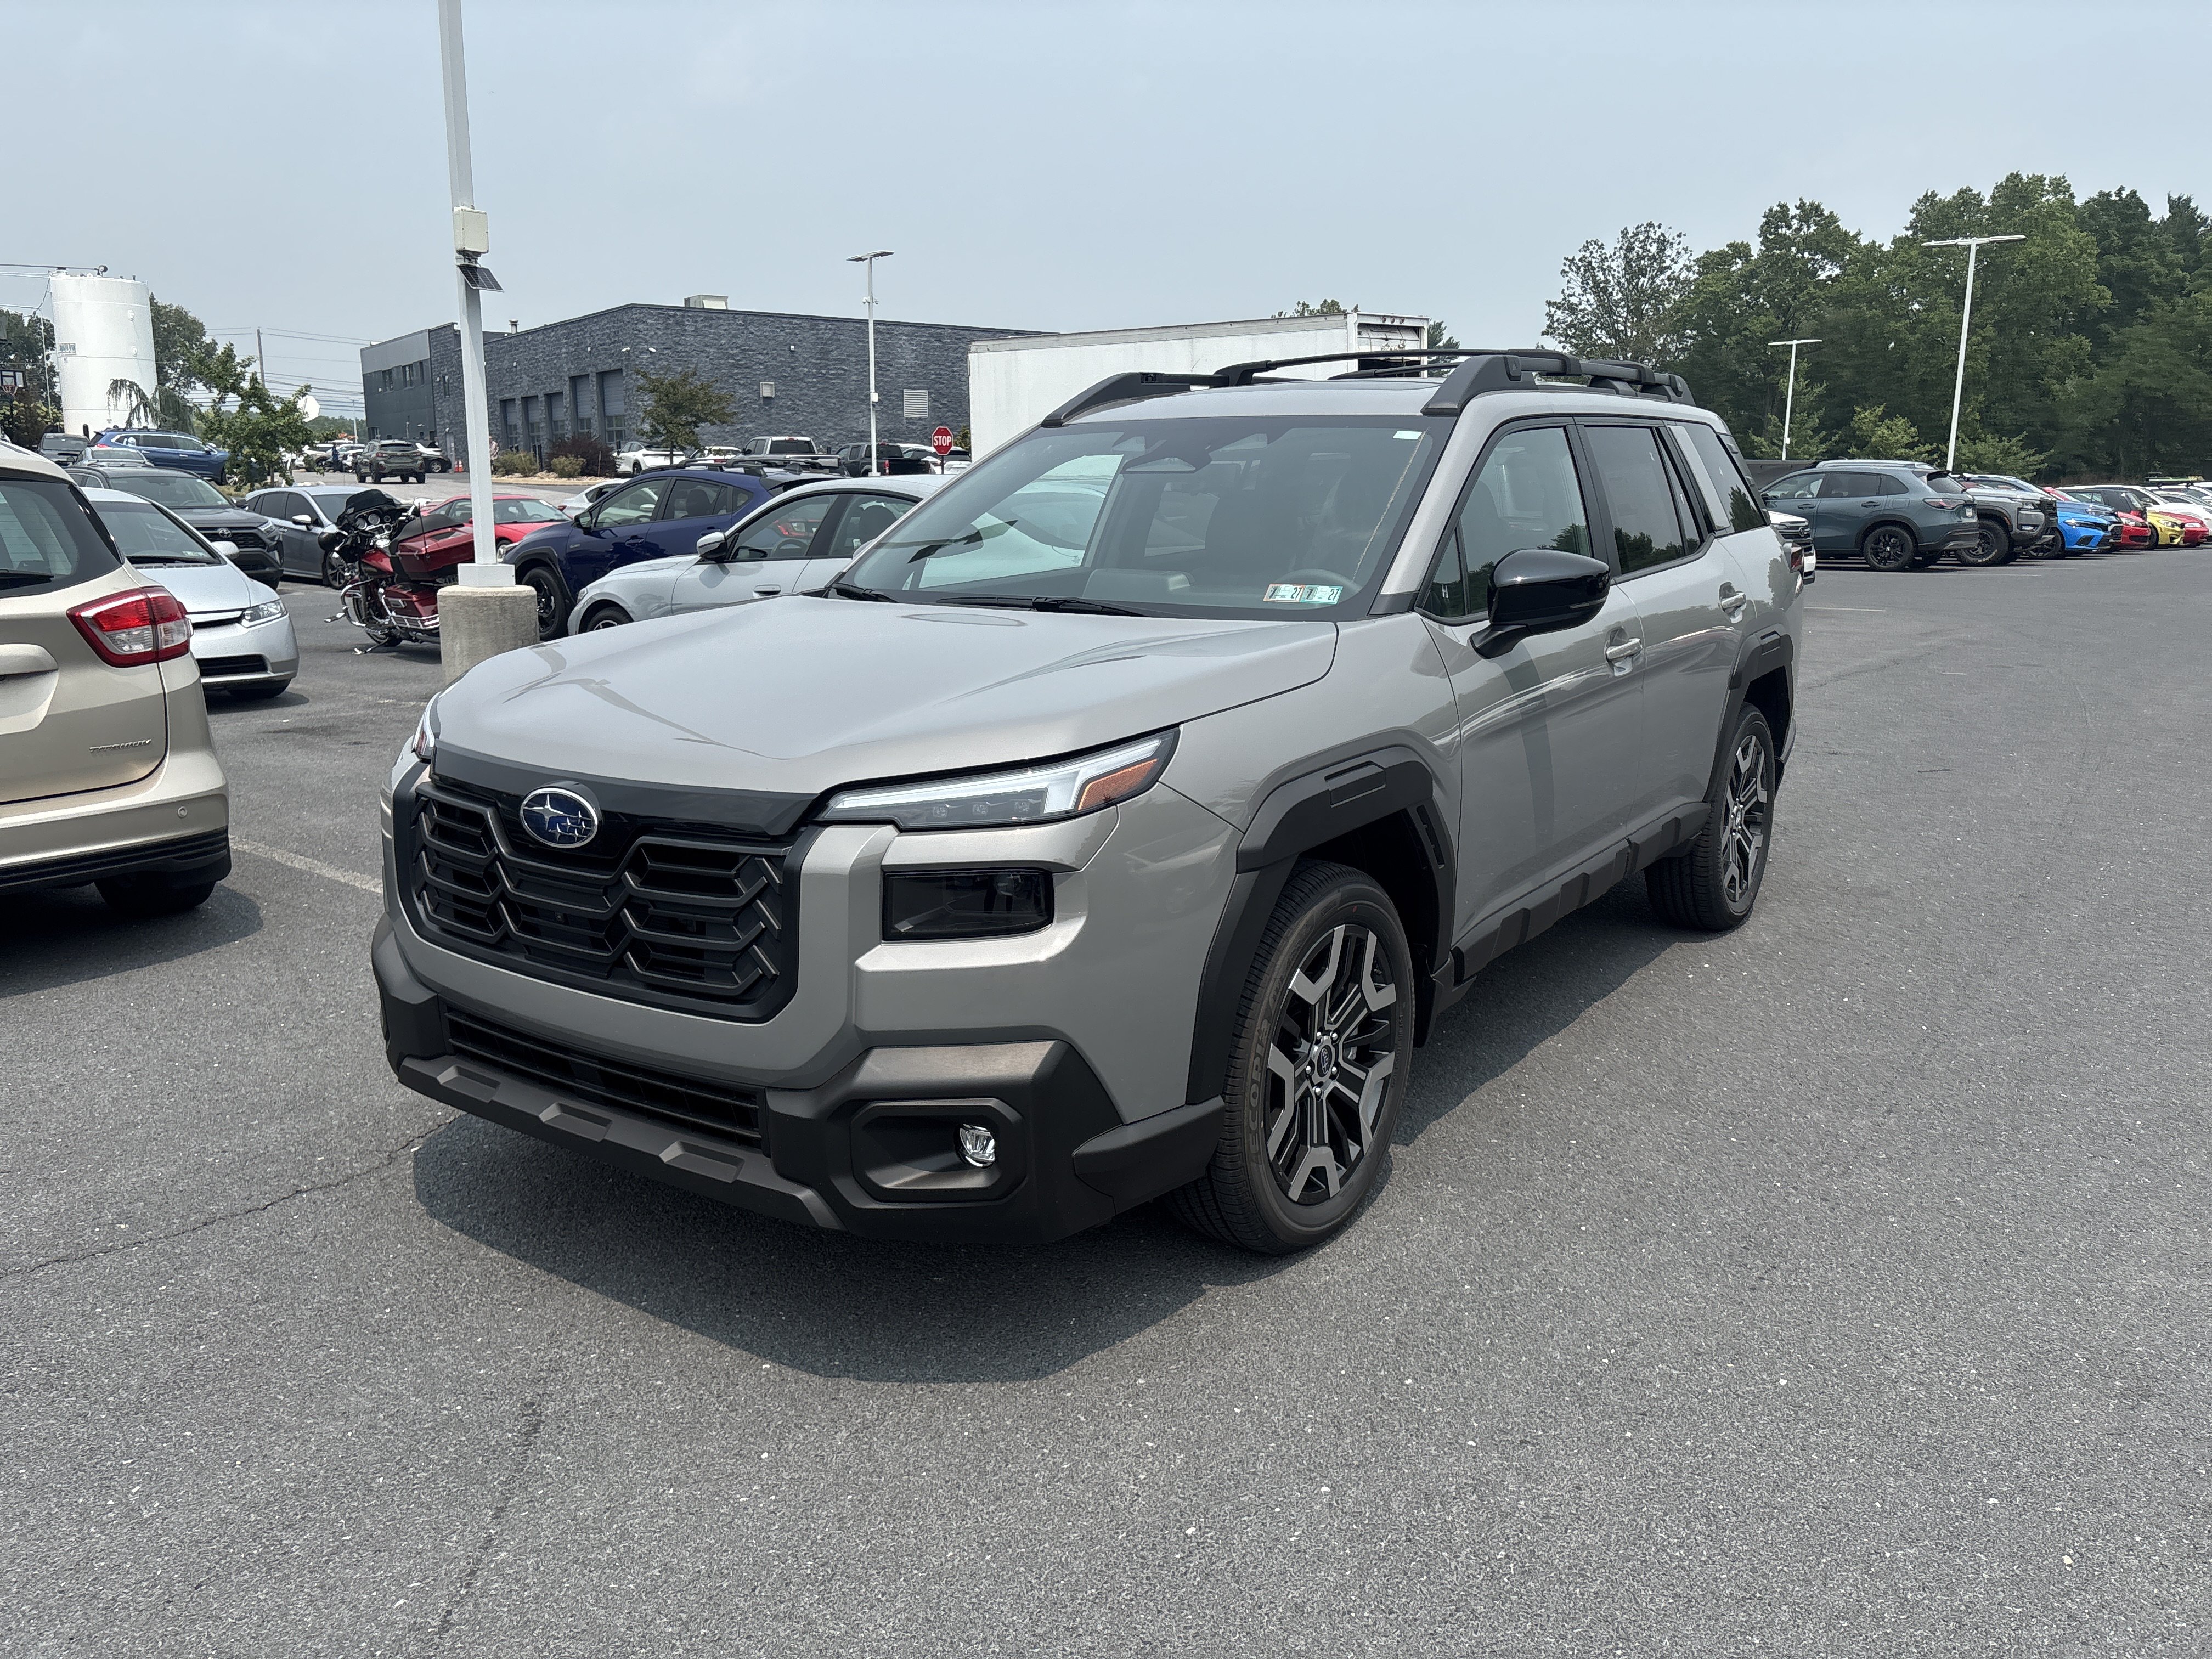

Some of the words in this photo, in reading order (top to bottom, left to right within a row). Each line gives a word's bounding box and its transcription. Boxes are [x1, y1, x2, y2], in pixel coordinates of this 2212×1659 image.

[934, 436, 951, 446] STOP
[1269, 588, 1277, 599] 7
[1290, 586, 1302, 599] 27
[1306, 589, 1314, 600] 7
[1328, 589, 1339, 601] 27
